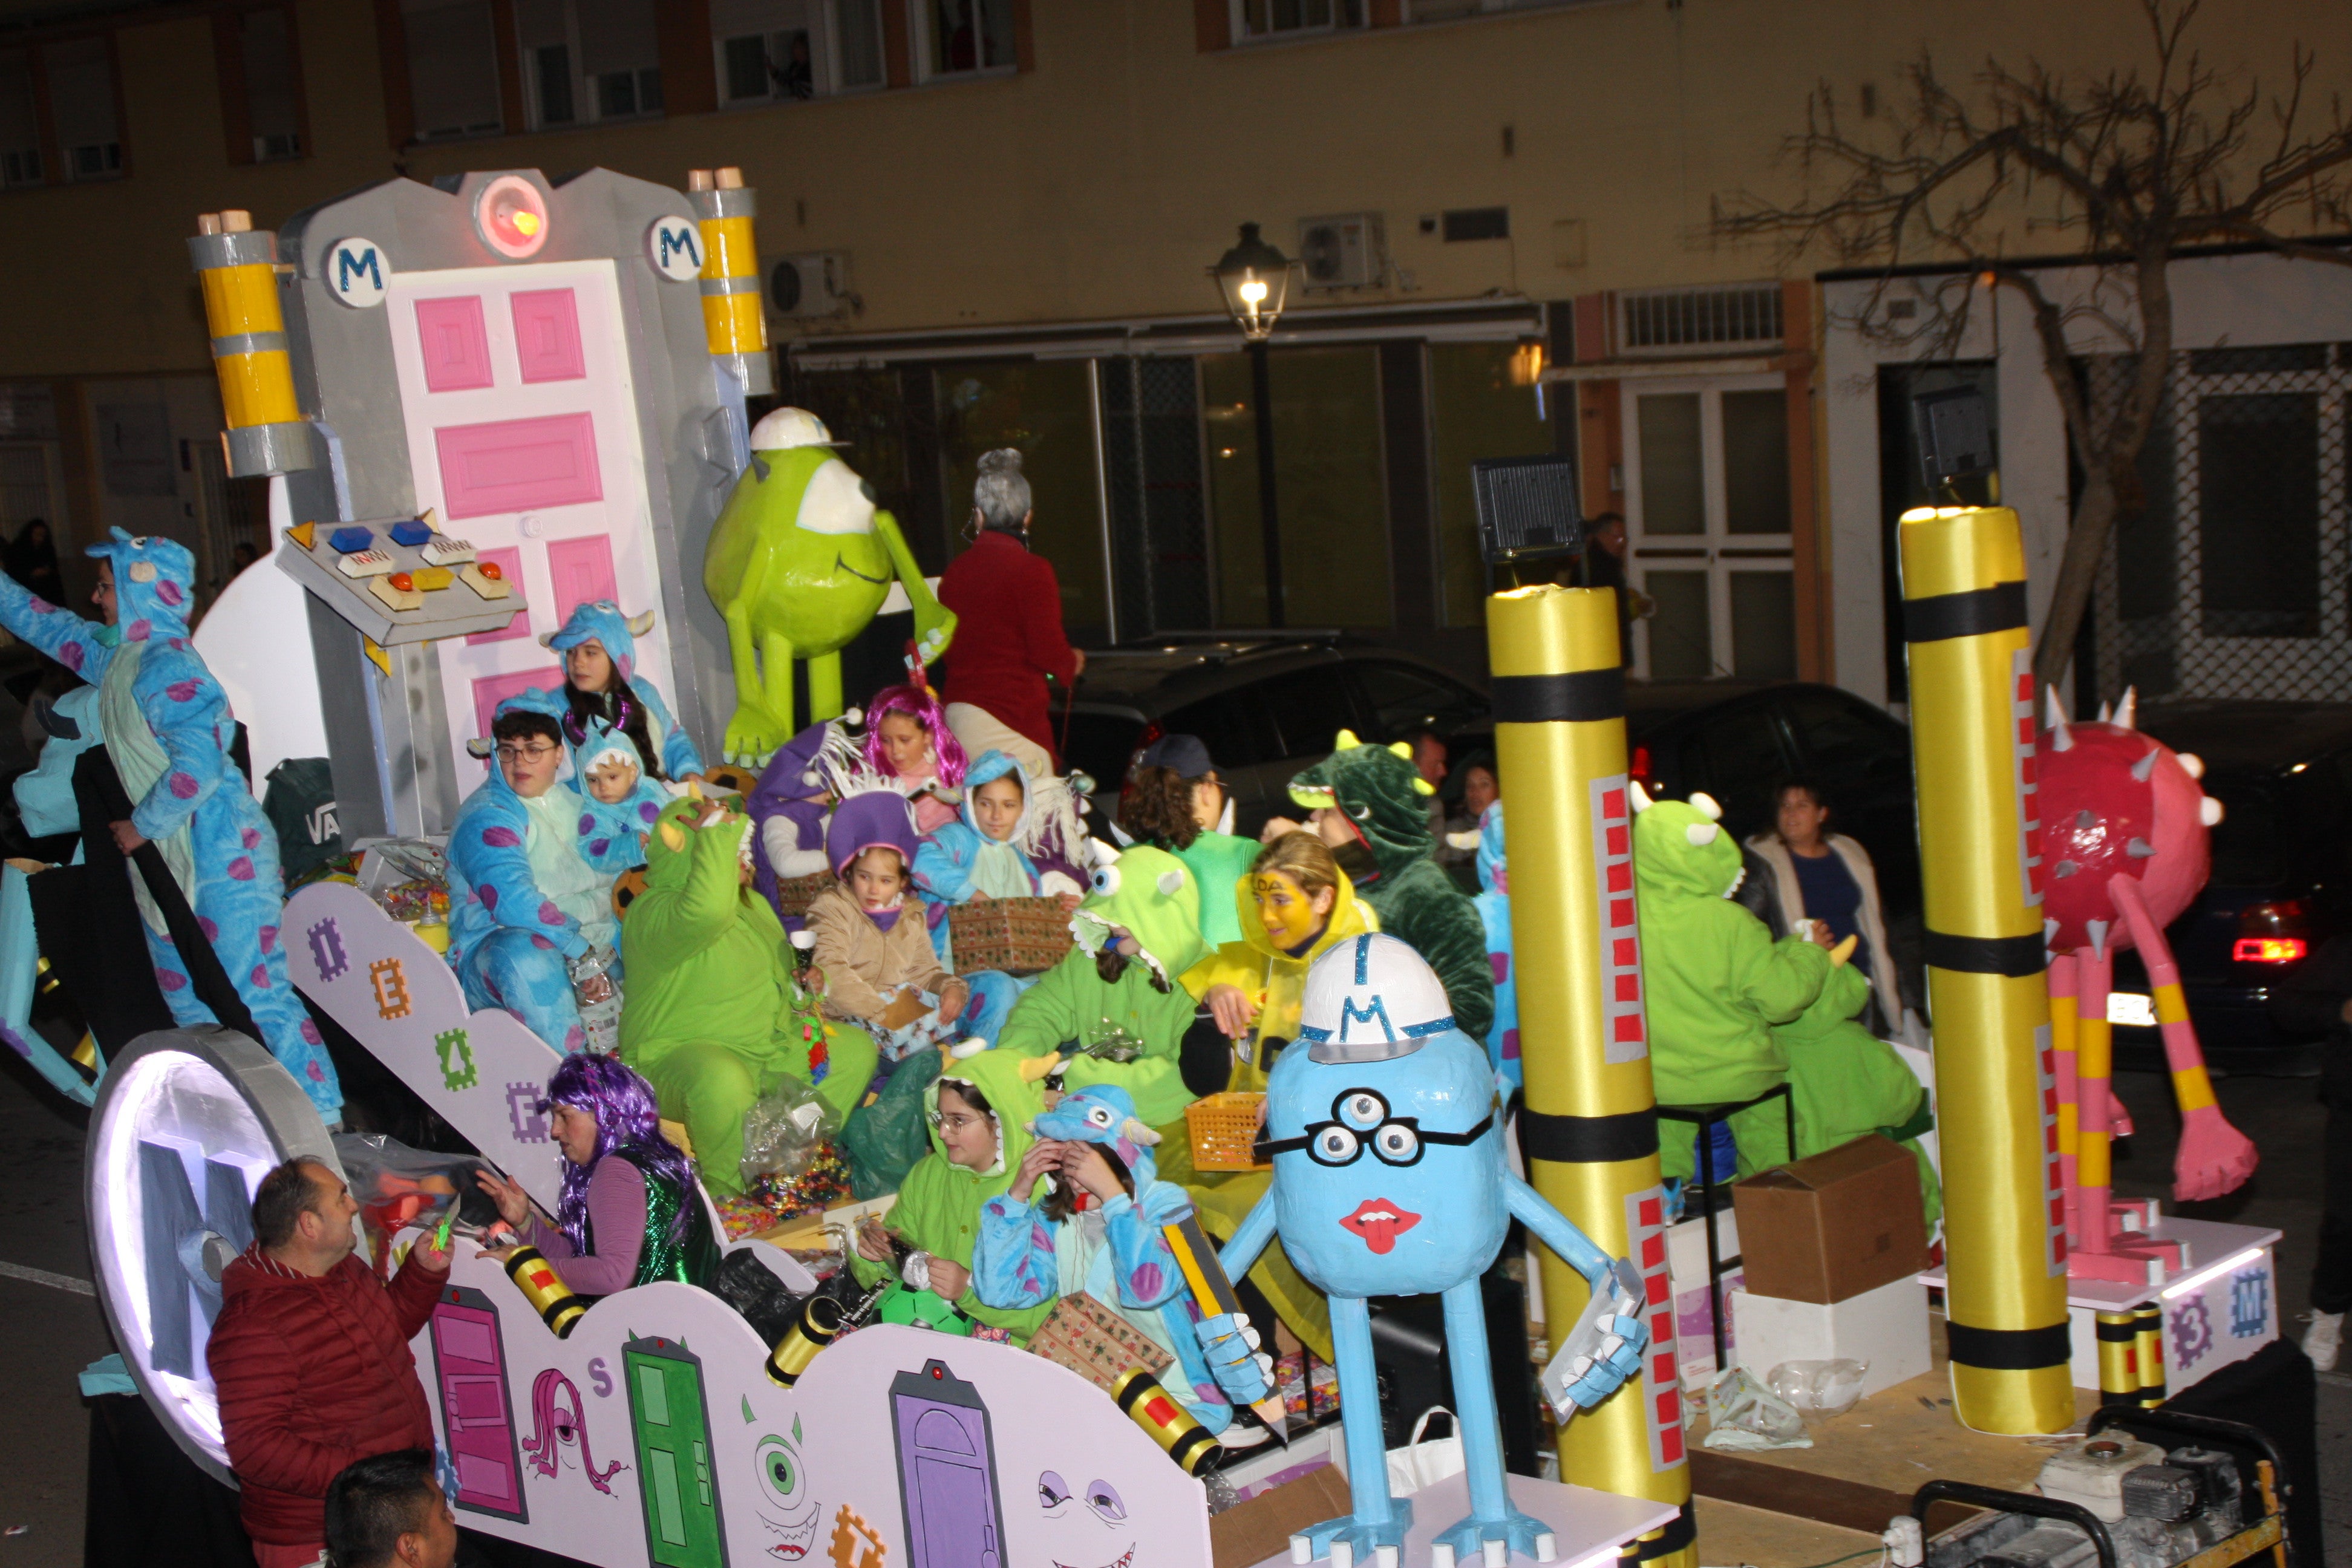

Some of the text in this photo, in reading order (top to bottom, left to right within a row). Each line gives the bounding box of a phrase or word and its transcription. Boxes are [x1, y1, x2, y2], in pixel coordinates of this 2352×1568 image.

[659, 227, 701, 268] M
[338, 247, 383, 293] M
[1339, 994, 1397, 1044] M
[587, 1357, 613, 1398] S
